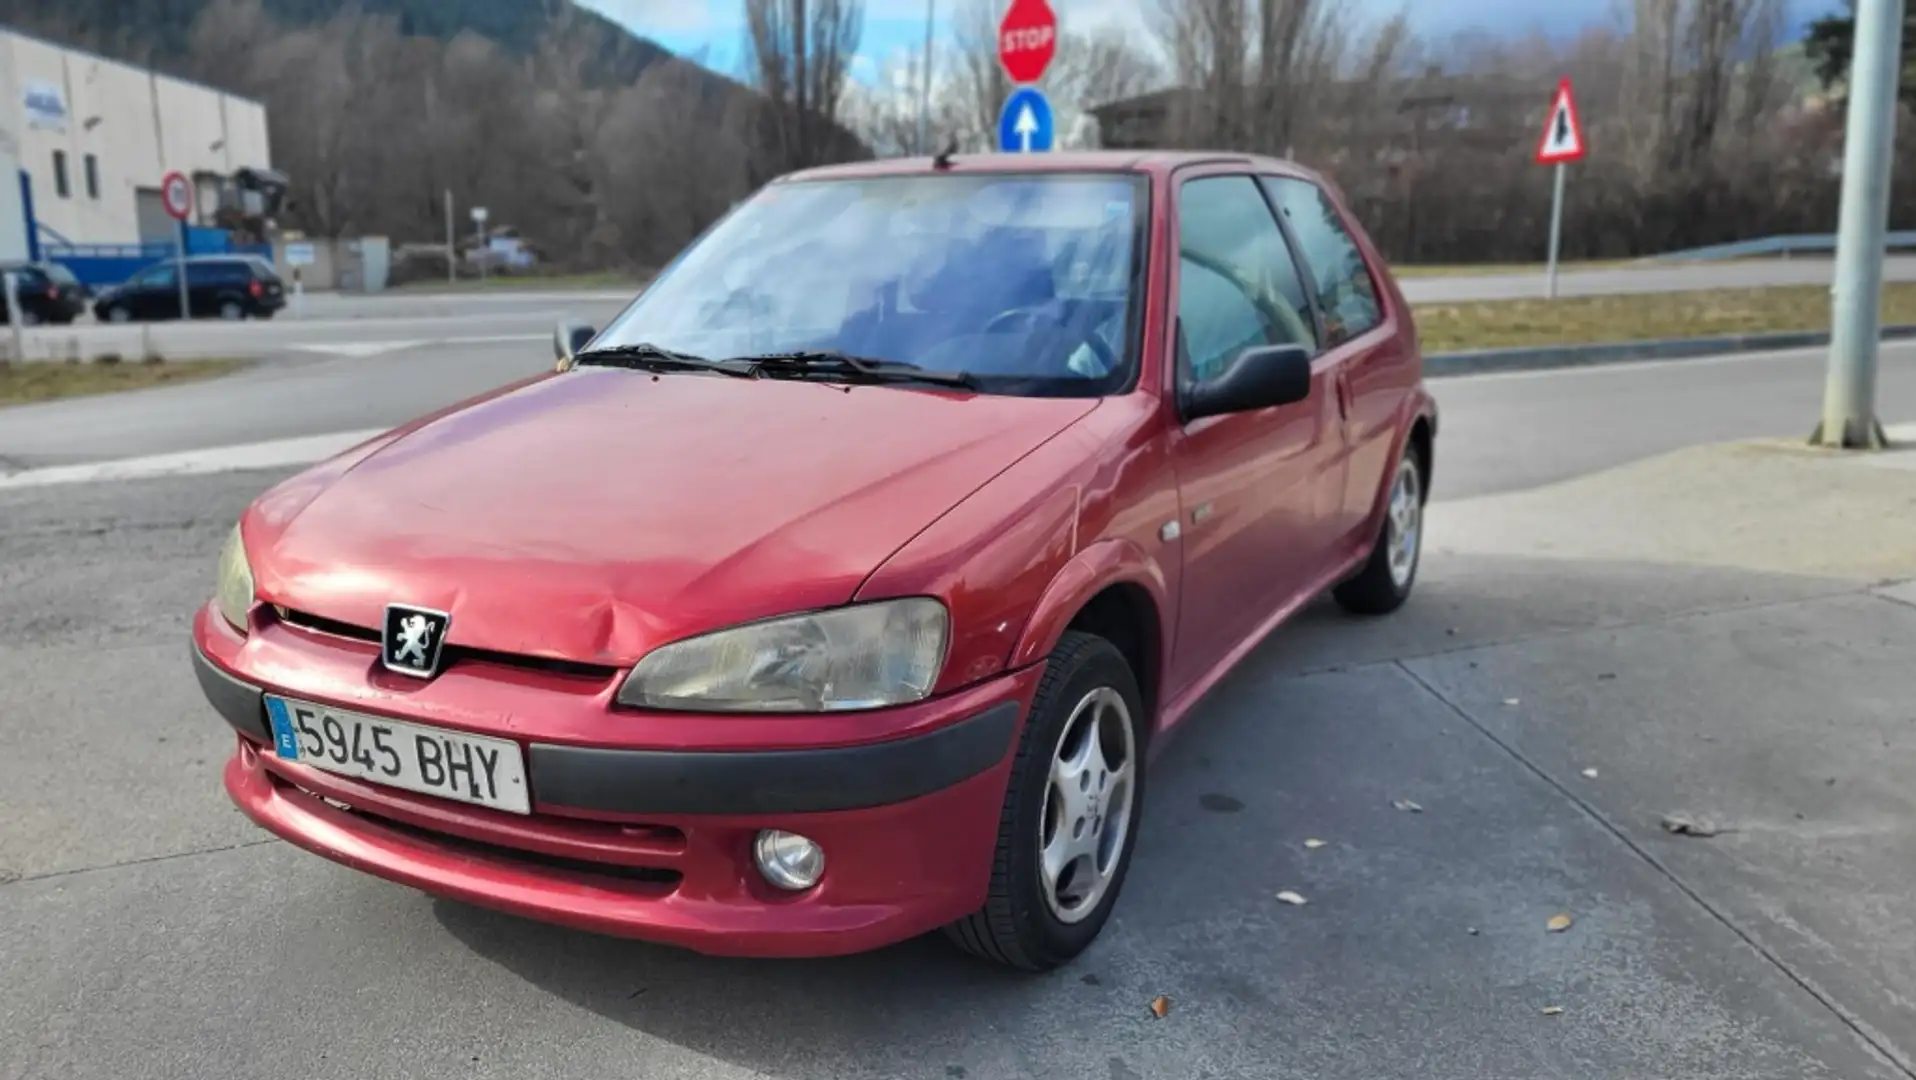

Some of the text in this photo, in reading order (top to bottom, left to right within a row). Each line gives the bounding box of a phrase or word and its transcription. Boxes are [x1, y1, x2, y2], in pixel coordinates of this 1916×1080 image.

[1001, 24, 1054, 53] STOP
[281, 733, 292, 749] E
[295, 708, 499, 799] 5945 BHY
